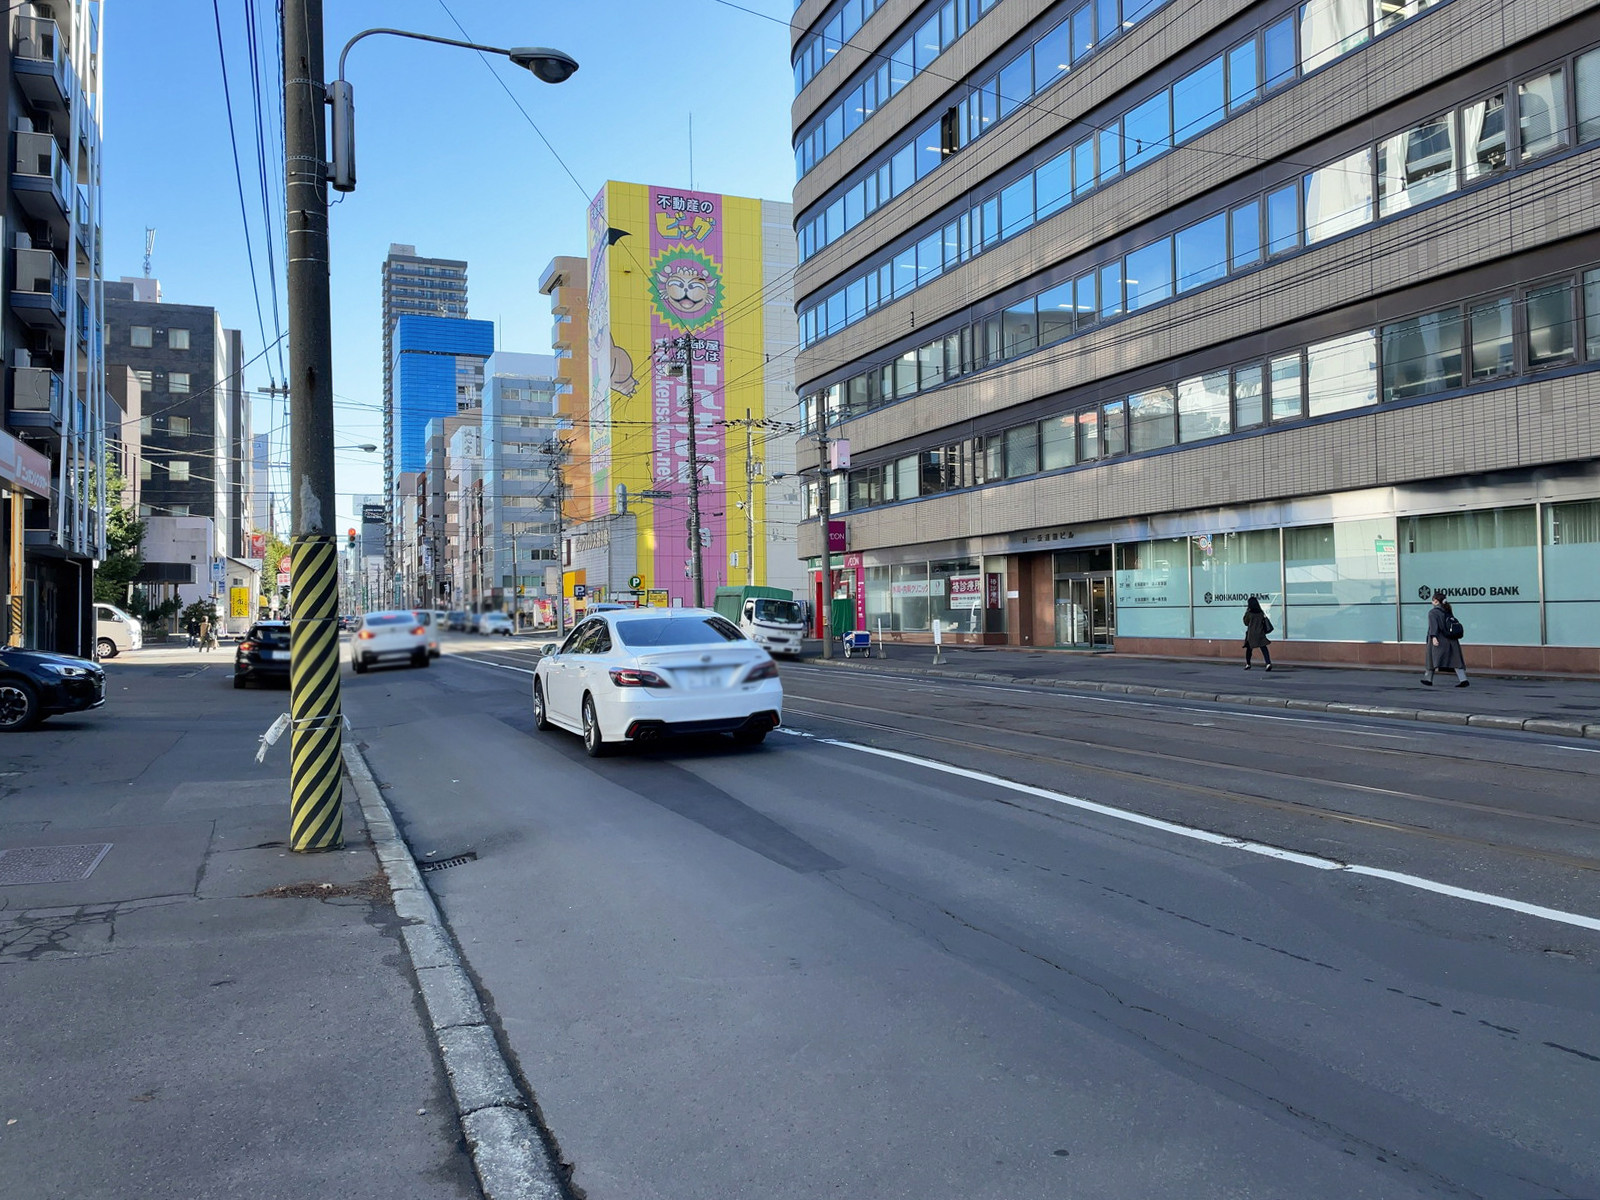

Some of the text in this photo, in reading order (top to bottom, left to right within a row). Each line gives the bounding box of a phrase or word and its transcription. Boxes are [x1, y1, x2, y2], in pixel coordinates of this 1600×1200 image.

[657, 194, 714, 213] 不動産の
[655, 211, 717, 243] ビッグ
[632, 577, 640, 587] P
[575, 586, 585, 596] P
[1433, 586, 1520, 597] HOKKAIDO BANK
[1214, 593, 1249, 602] HOKKAIDO
